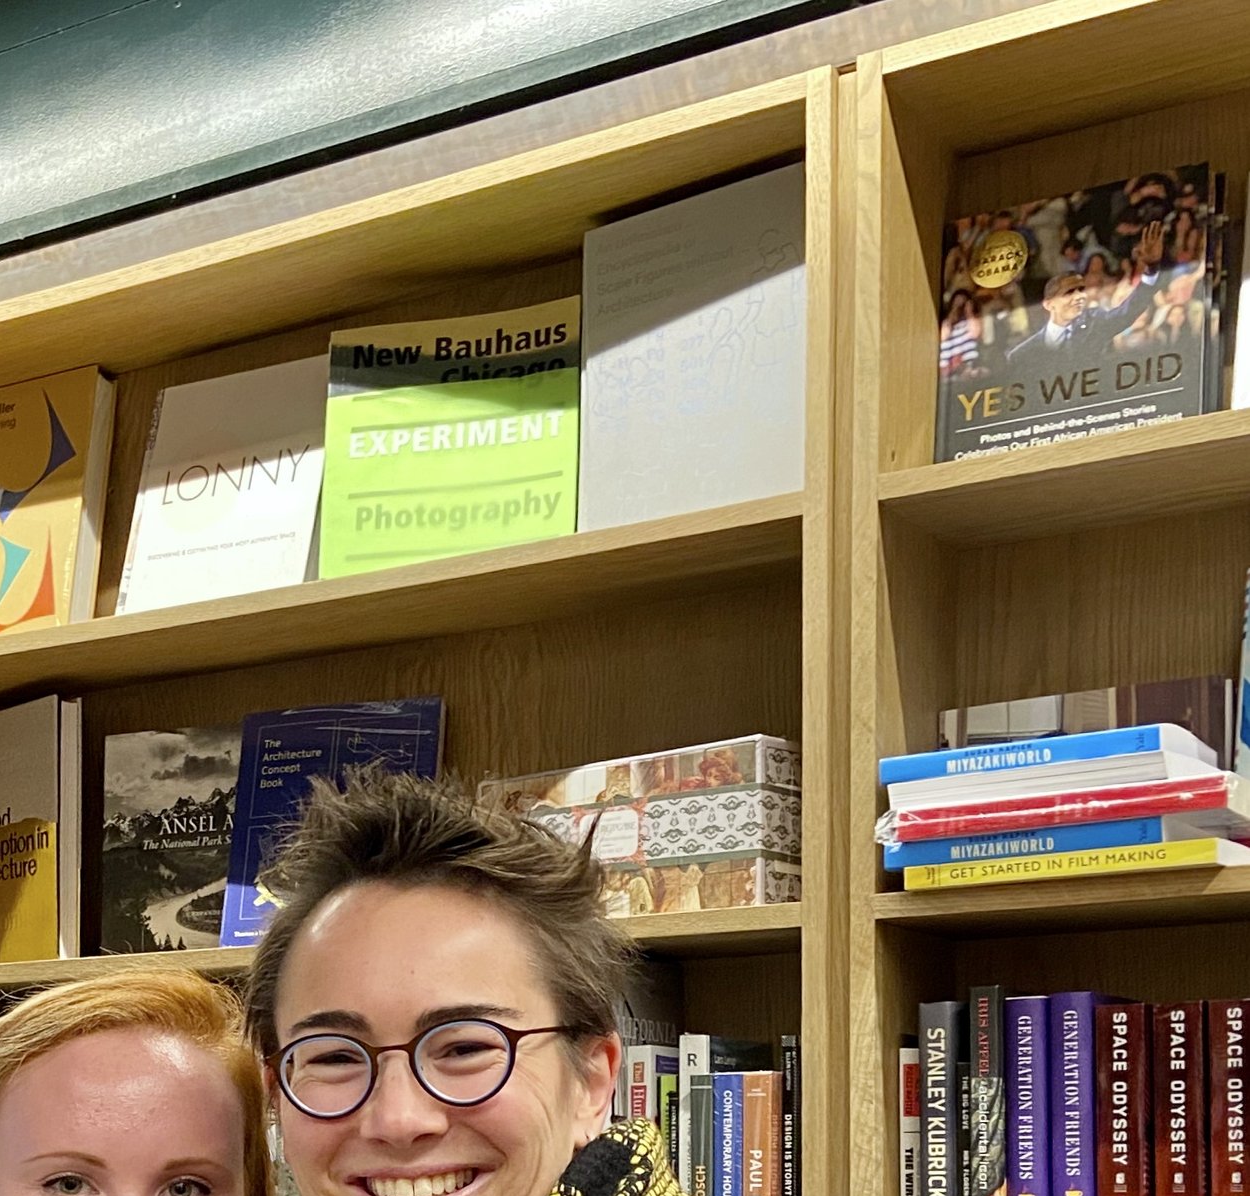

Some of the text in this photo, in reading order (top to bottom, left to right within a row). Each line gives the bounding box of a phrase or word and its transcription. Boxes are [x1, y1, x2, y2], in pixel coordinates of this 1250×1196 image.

[352, 322, 567, 370] New Bauhaus
[957, 352, 1183, 421] YES WE DID
[350, 411, 564, 459] EXPERIMENT
[979, 404, 1157, 445] Photos and Behind-the-Scenes Stories
[1010, 441, 1029, 452] Our
[1030, 436, 1052, 448] First
[1053, 429, 1087, 445] African
[1088, 420, 1137, 439] American
[1137, 411, 1183, 429] President
[161, 444, 311, 506] LONNY
[355, 489, 562, 532] Photography
[262, 748, 322, 762] Architecture
[263, 738, 281, 749] The
[946, 747, 1052, 774] MIYAZAKIWORLD
[259, 778, 283, 789] Book
[261, 762, 301, 776] Concept
[37, 825, 49, 850] in
[143, 834, 222, 850] The National Park
[159, 814, 217, 836] ANSEL
[949, 865, 976, 880] GET
[981, 860, 1041, 877] STARTED
[1047, 858, 1063, 870] IN
[1068, 854, 1100, 869] FILM
[1105, 848, 1167, 865] MAKING
[950, 836, 1055, 860] MIYAZAKIWORLD
[978, 997, 988, 1026] IRIS
[687, 1053, 698, 1067] R
[927, 1028, 946, 1112] STANLEY
[1017, 1015, 1034, 1179] GENERATION FRIENDS
[1062, 1010, 1081, 1176] GENERATION FRIENDS
[1112, 1012, 1127, 1165] SPACE ODYSSEY
[1170, 1010, 1186, 1165] SPACE ODYSSEY
[1227, 1007, 1244, 1164] SPACE ODYSSEY
[722, 1090, 733, 1173] CONTEMPORARY
[784, 1114, 793, 1148] DESIGN
[978, 1086, 990, 1190] accidental icon
[749, 1150, 763, 1191] PAUL
[784, 1151, 793, 1160] IS
[905, 1146, 915, 1171] THE
